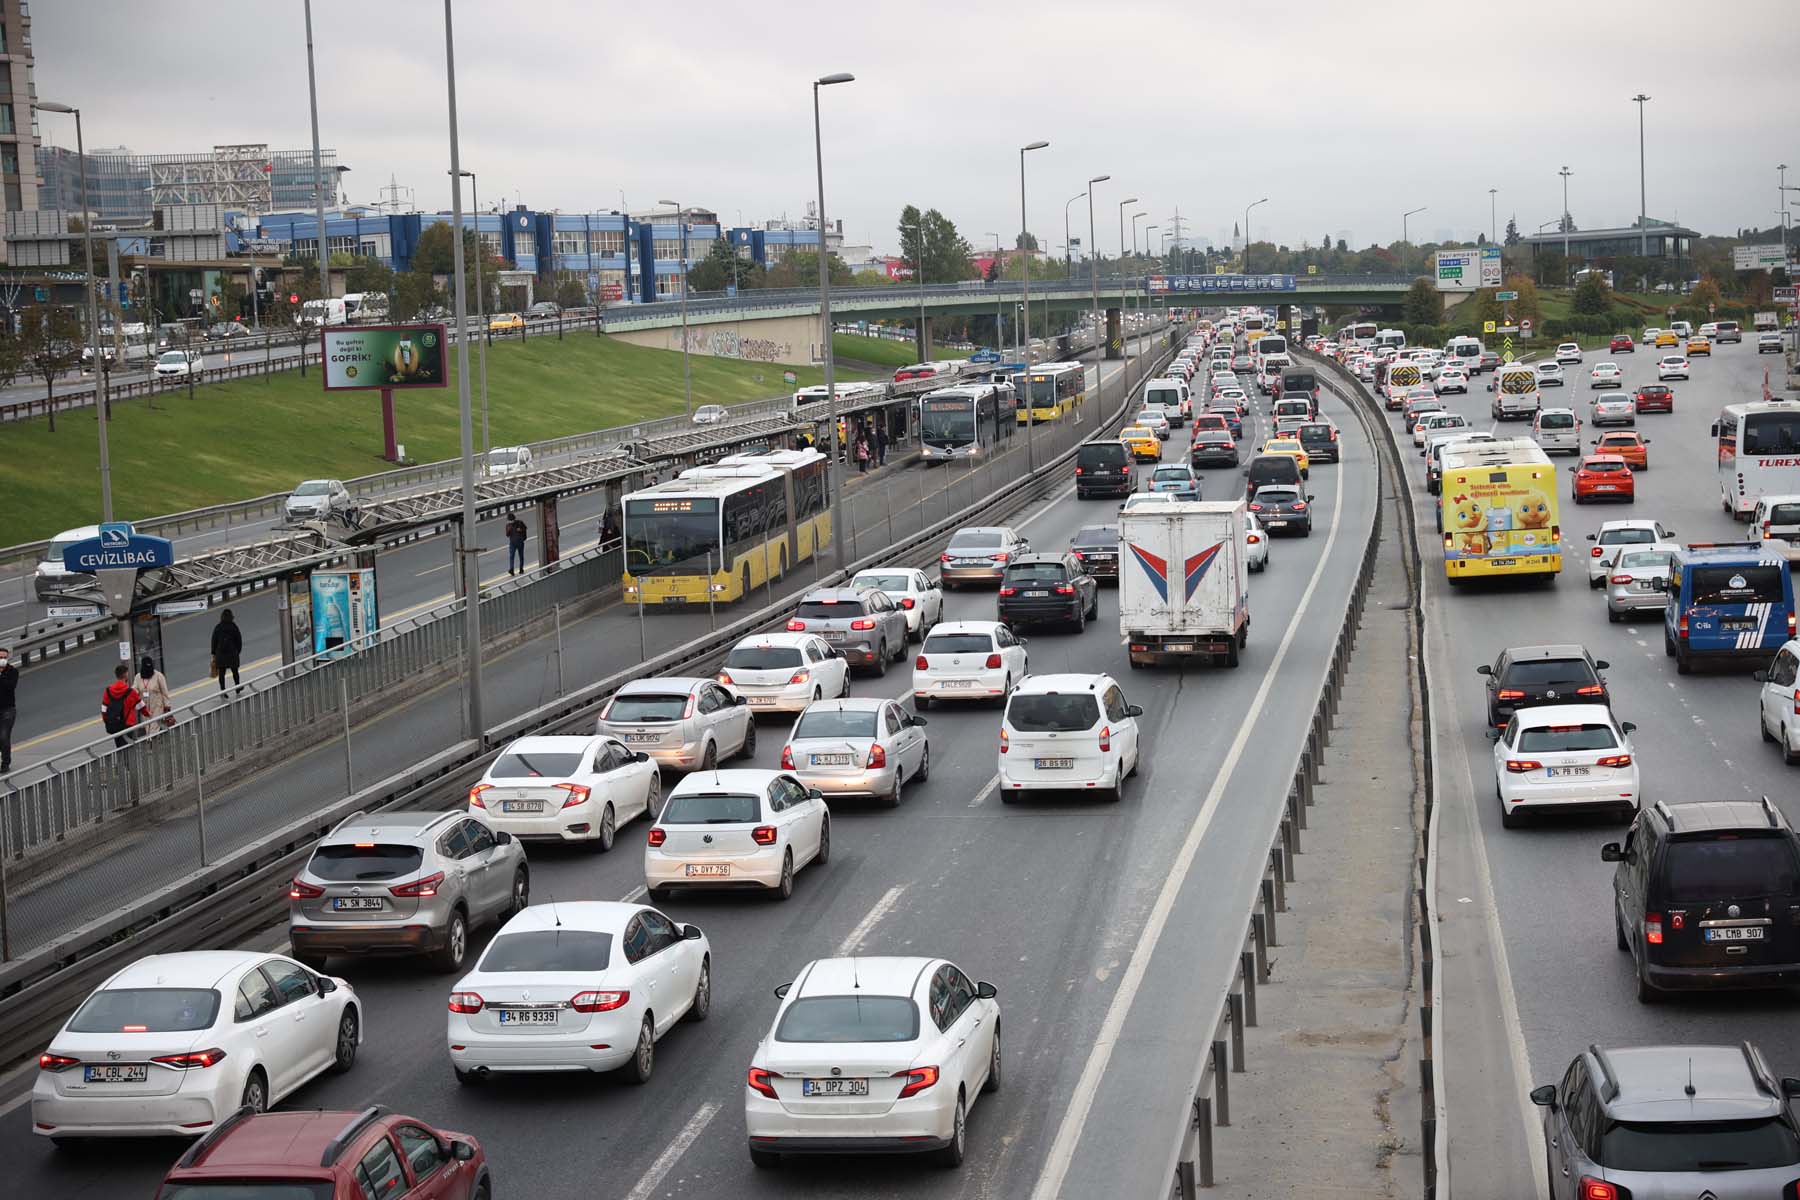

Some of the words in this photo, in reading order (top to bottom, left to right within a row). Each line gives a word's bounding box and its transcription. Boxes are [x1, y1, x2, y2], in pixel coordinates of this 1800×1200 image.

[80, 550, 156, 566] CEVİZLİBAĞ
[1552, 767, 1560, 776] 34
[339, 897, 347, 907] 34
[363, 897, 380, 907] 3844
[1711, 930, 1721, 939] 34
[1726, 929, 1742, 938] CMB
[1747, 928, 1762, 937] 907
[506, 1011, 516, 1021] 34
[519, 1011, 530, 1021] RG
[533, 1010, 554, 1021] 9339
[92, 1067, 101, 1078] 34
[106, 1067, 122, 1078] CBL
[128, 1067, 144, 1078] 244
[810, 1081, 820, 1092] 34
[826, 1081, 843, 1092] DPZ
[849, 1081, 865, 1092] 304
